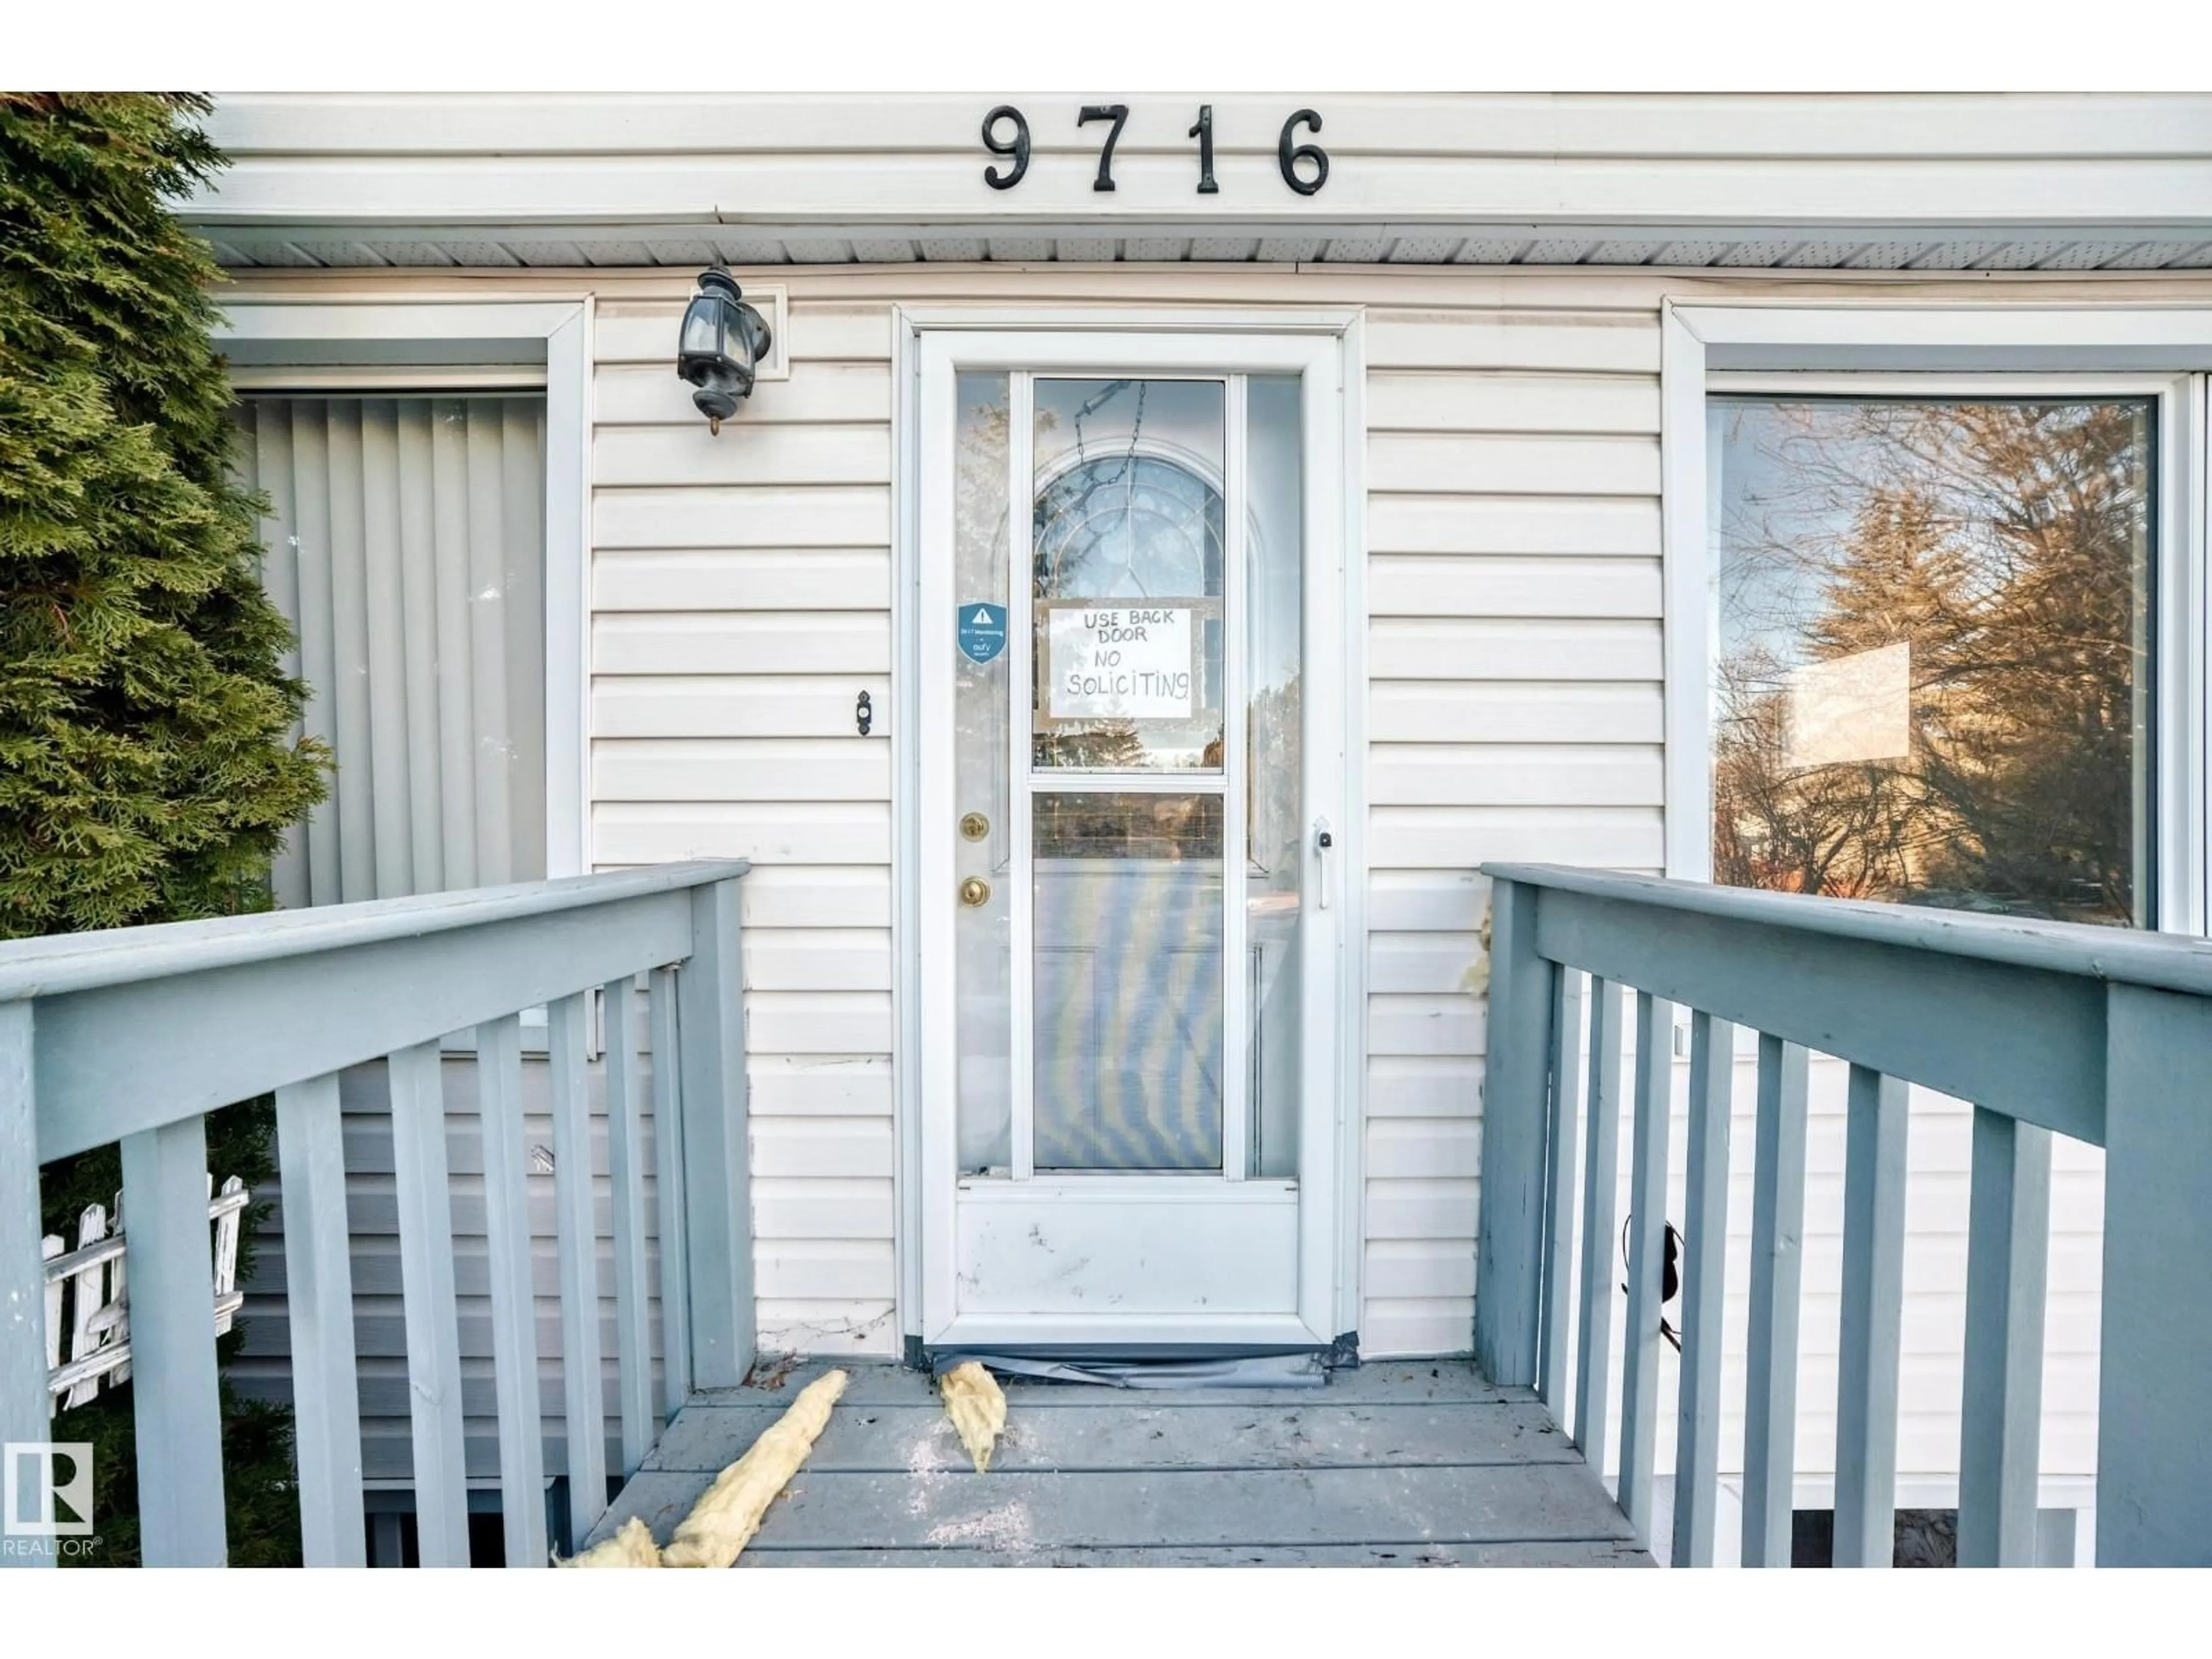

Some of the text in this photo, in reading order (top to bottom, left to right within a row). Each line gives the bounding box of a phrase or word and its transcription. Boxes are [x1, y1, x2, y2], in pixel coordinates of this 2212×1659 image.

[982, 104, 1330, 195] 9716
[1084, 610, 1175, 628] USE BACK
[1098, 626, 1147, 643] DOOR
[1094, 650, 1121, 667] NO
